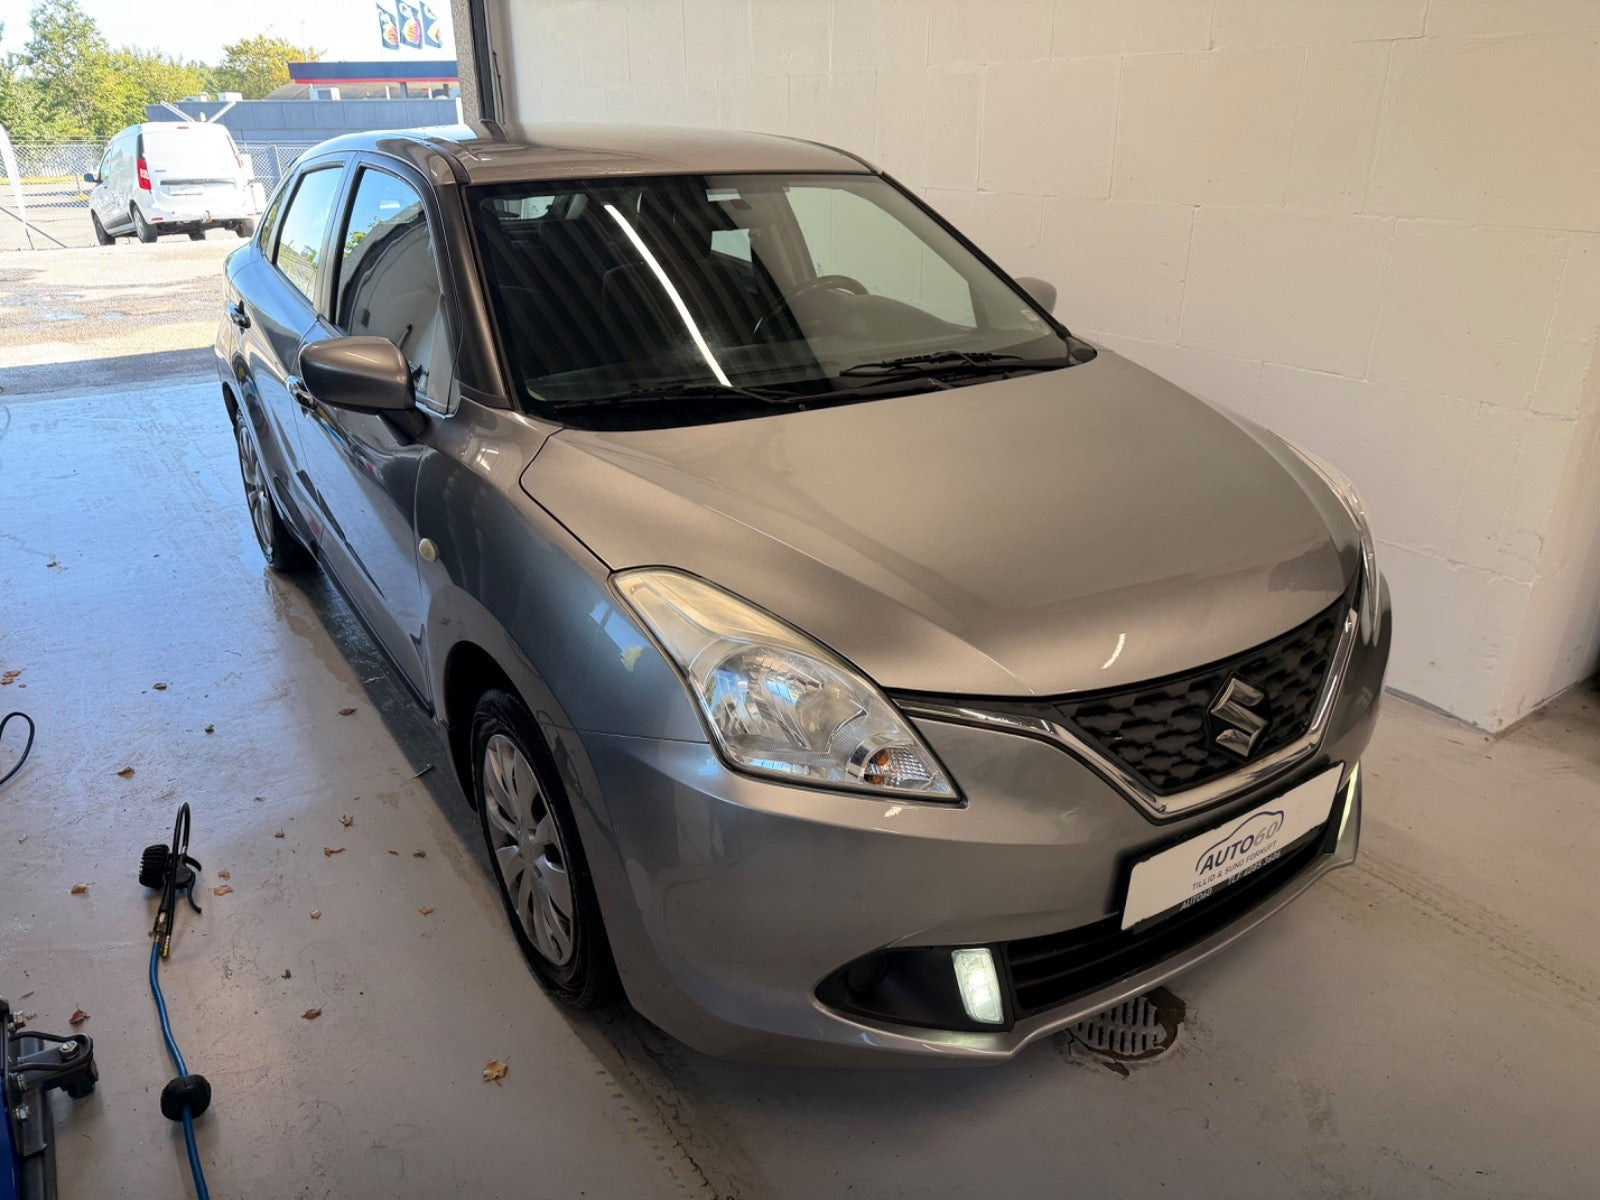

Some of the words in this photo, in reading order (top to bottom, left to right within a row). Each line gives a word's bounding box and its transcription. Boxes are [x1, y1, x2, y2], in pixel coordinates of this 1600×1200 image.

[1199, 820, 1279, 876] AUTO60
[1192, 873, 1216, 890] TILLID
[1217, 869, 1223, 877] &
